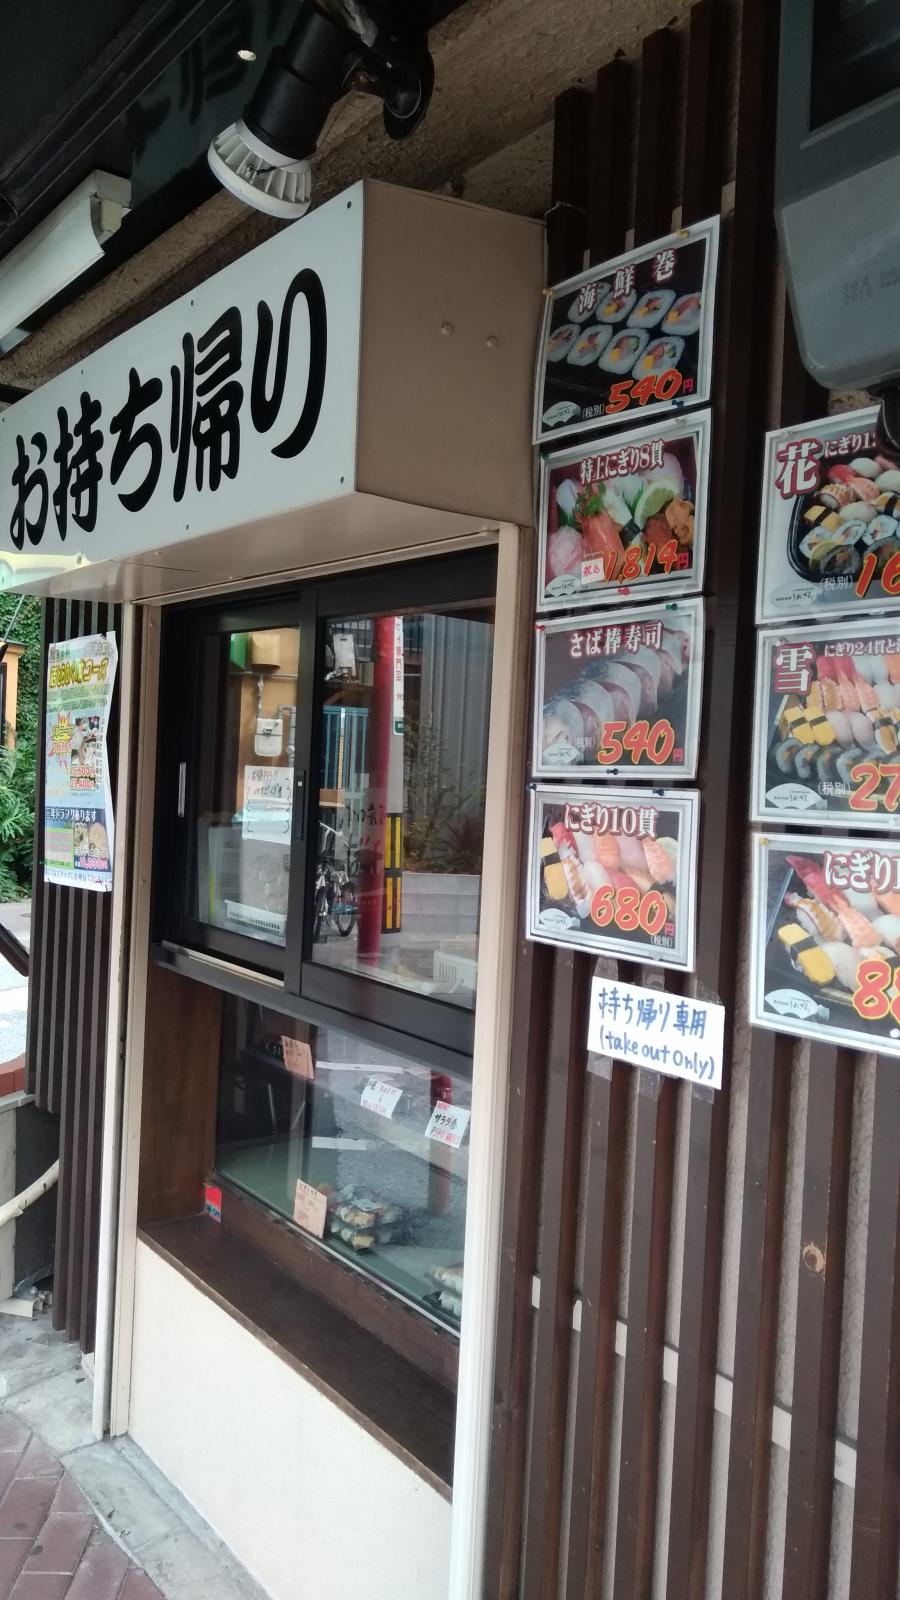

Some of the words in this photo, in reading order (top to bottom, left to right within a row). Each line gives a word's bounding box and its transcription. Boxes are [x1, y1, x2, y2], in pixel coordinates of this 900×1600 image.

[577, 248, 677, 313] 海鮮巻
[10, 267, 328, 550] お持ち帰り
[580, 439, 665, 485] 特上にぎり8貫
[776, 438, 822, 499] 花
[570, 621, 663, 658] さば棒寿司
[774, 641, 815, 696] 雪
[824, 638, 900, 657] にぎり24貫と
[564, 802, 657, 838] にぎり10貫
[598, 987, 707, 1039] 持ち帰り専用
[852, 960, 900, 1023] 8
[600, 1025, 639, 1055] (take
[641, 1045, 670, 1064] out
